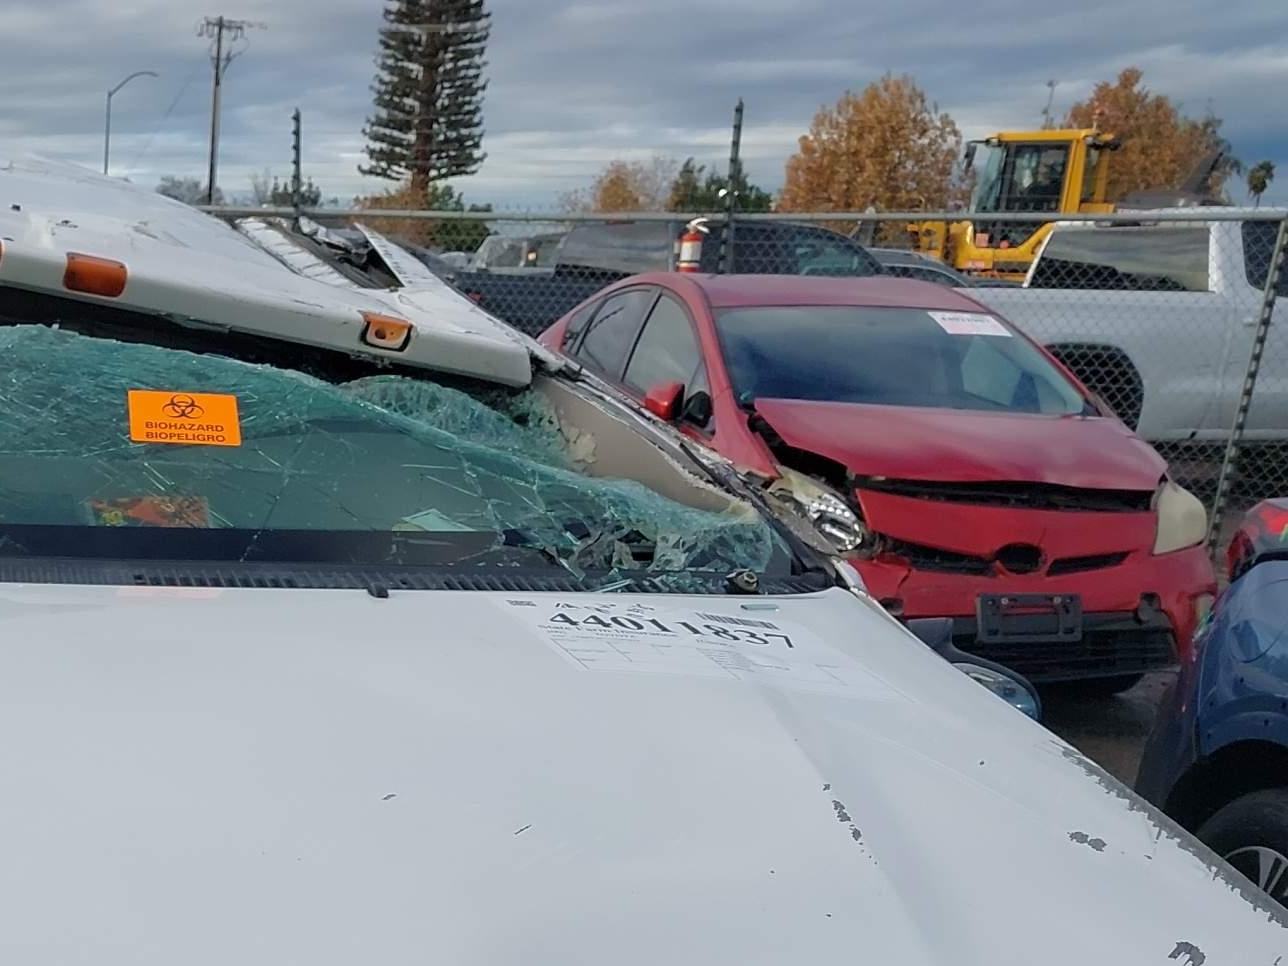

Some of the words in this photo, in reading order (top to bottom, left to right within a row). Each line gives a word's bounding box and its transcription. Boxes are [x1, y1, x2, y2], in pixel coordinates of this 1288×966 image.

[145, 421, 225, 432] BIOHAZARD
[145, 431, 226, 443] BIOPELIGRO
[549, 612, 795, 649] 44011837
